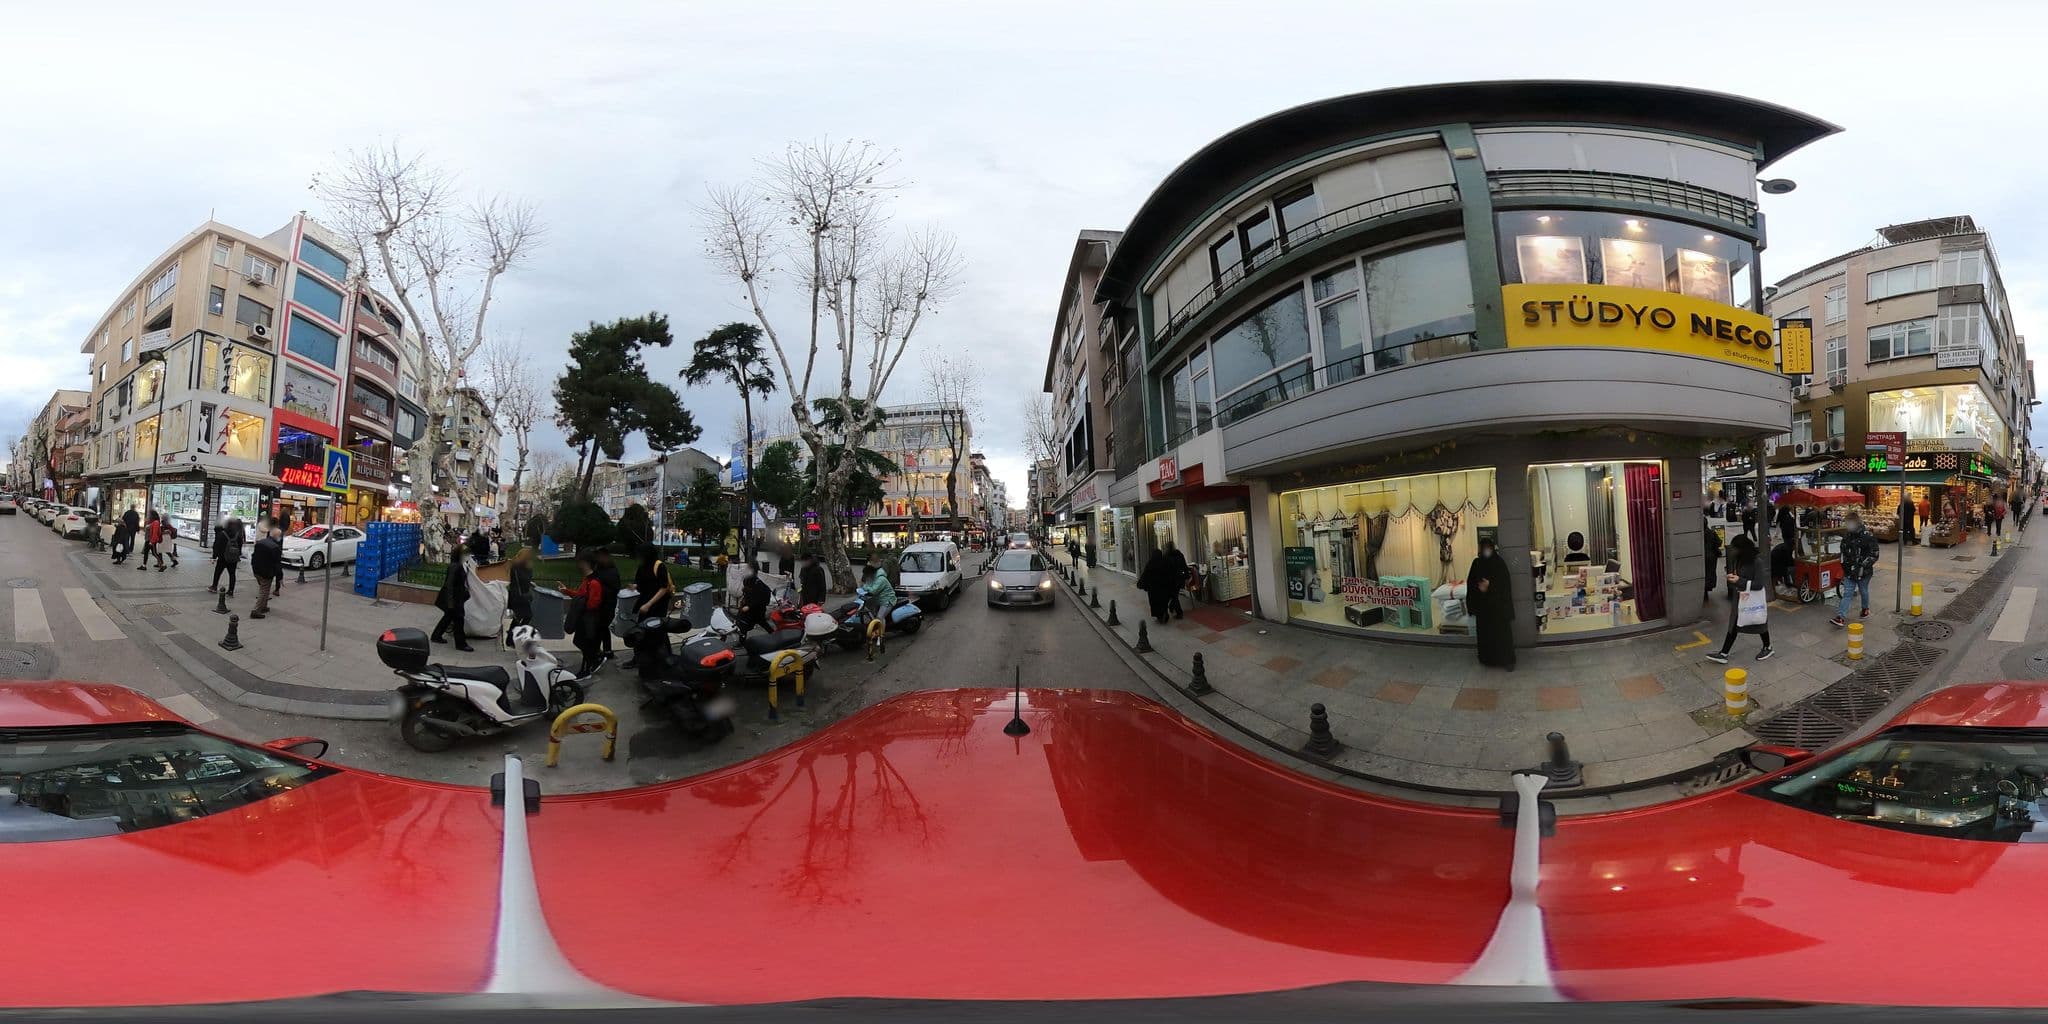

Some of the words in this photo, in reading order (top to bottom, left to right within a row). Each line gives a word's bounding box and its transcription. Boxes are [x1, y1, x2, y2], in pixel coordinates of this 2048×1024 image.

[1521, 295, 1677, 329] STÜDYO
[1690, 312, 1773, 351] NECO
[281, 467, 313, 487] ZURNA
[1160, 459, 1175, 480] TAÇ
[1341, 584, 1374, 596] DUVAR
